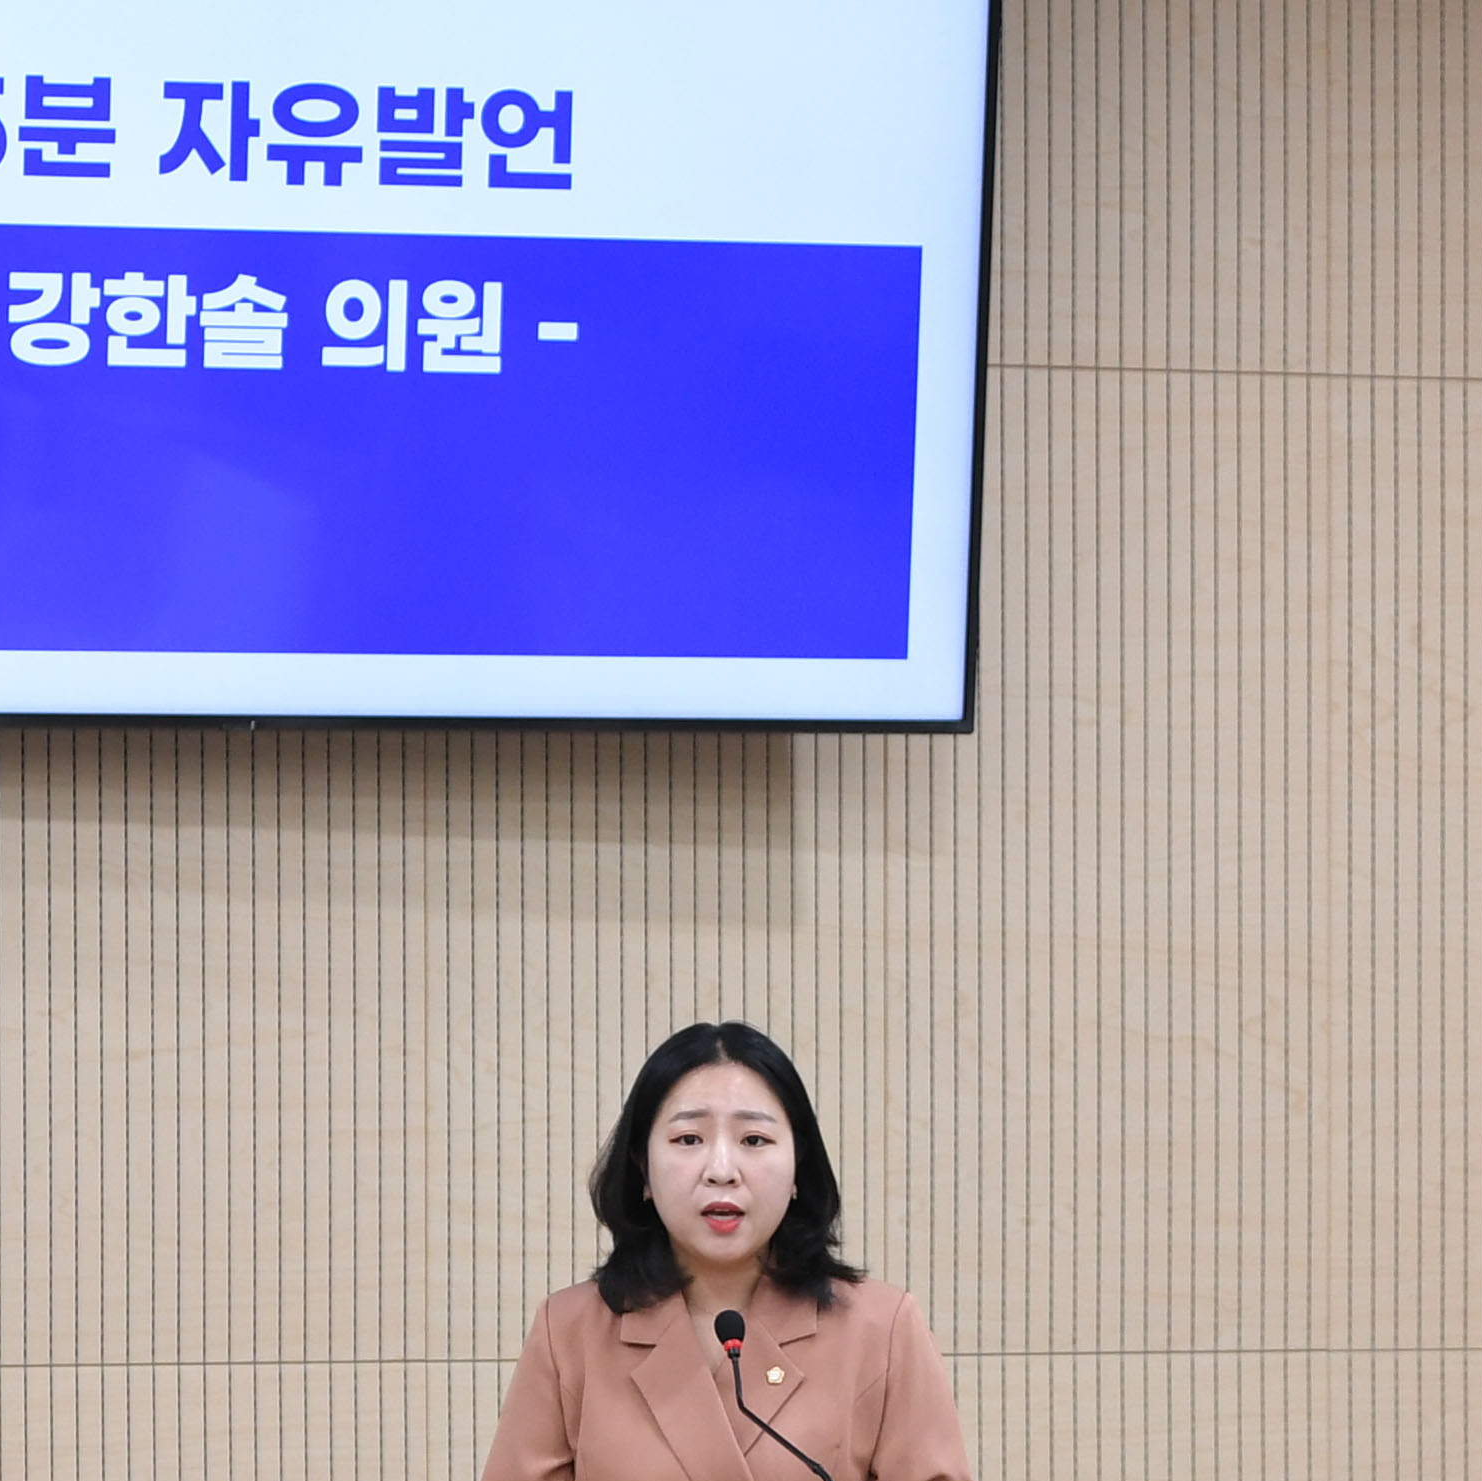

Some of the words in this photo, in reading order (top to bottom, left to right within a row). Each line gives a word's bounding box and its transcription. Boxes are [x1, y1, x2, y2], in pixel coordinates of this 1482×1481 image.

[159, 80, 573, 190] 자유발언
[8, 271, 287, 369] 강한솔
[322, 278, 502, 373] 의원
